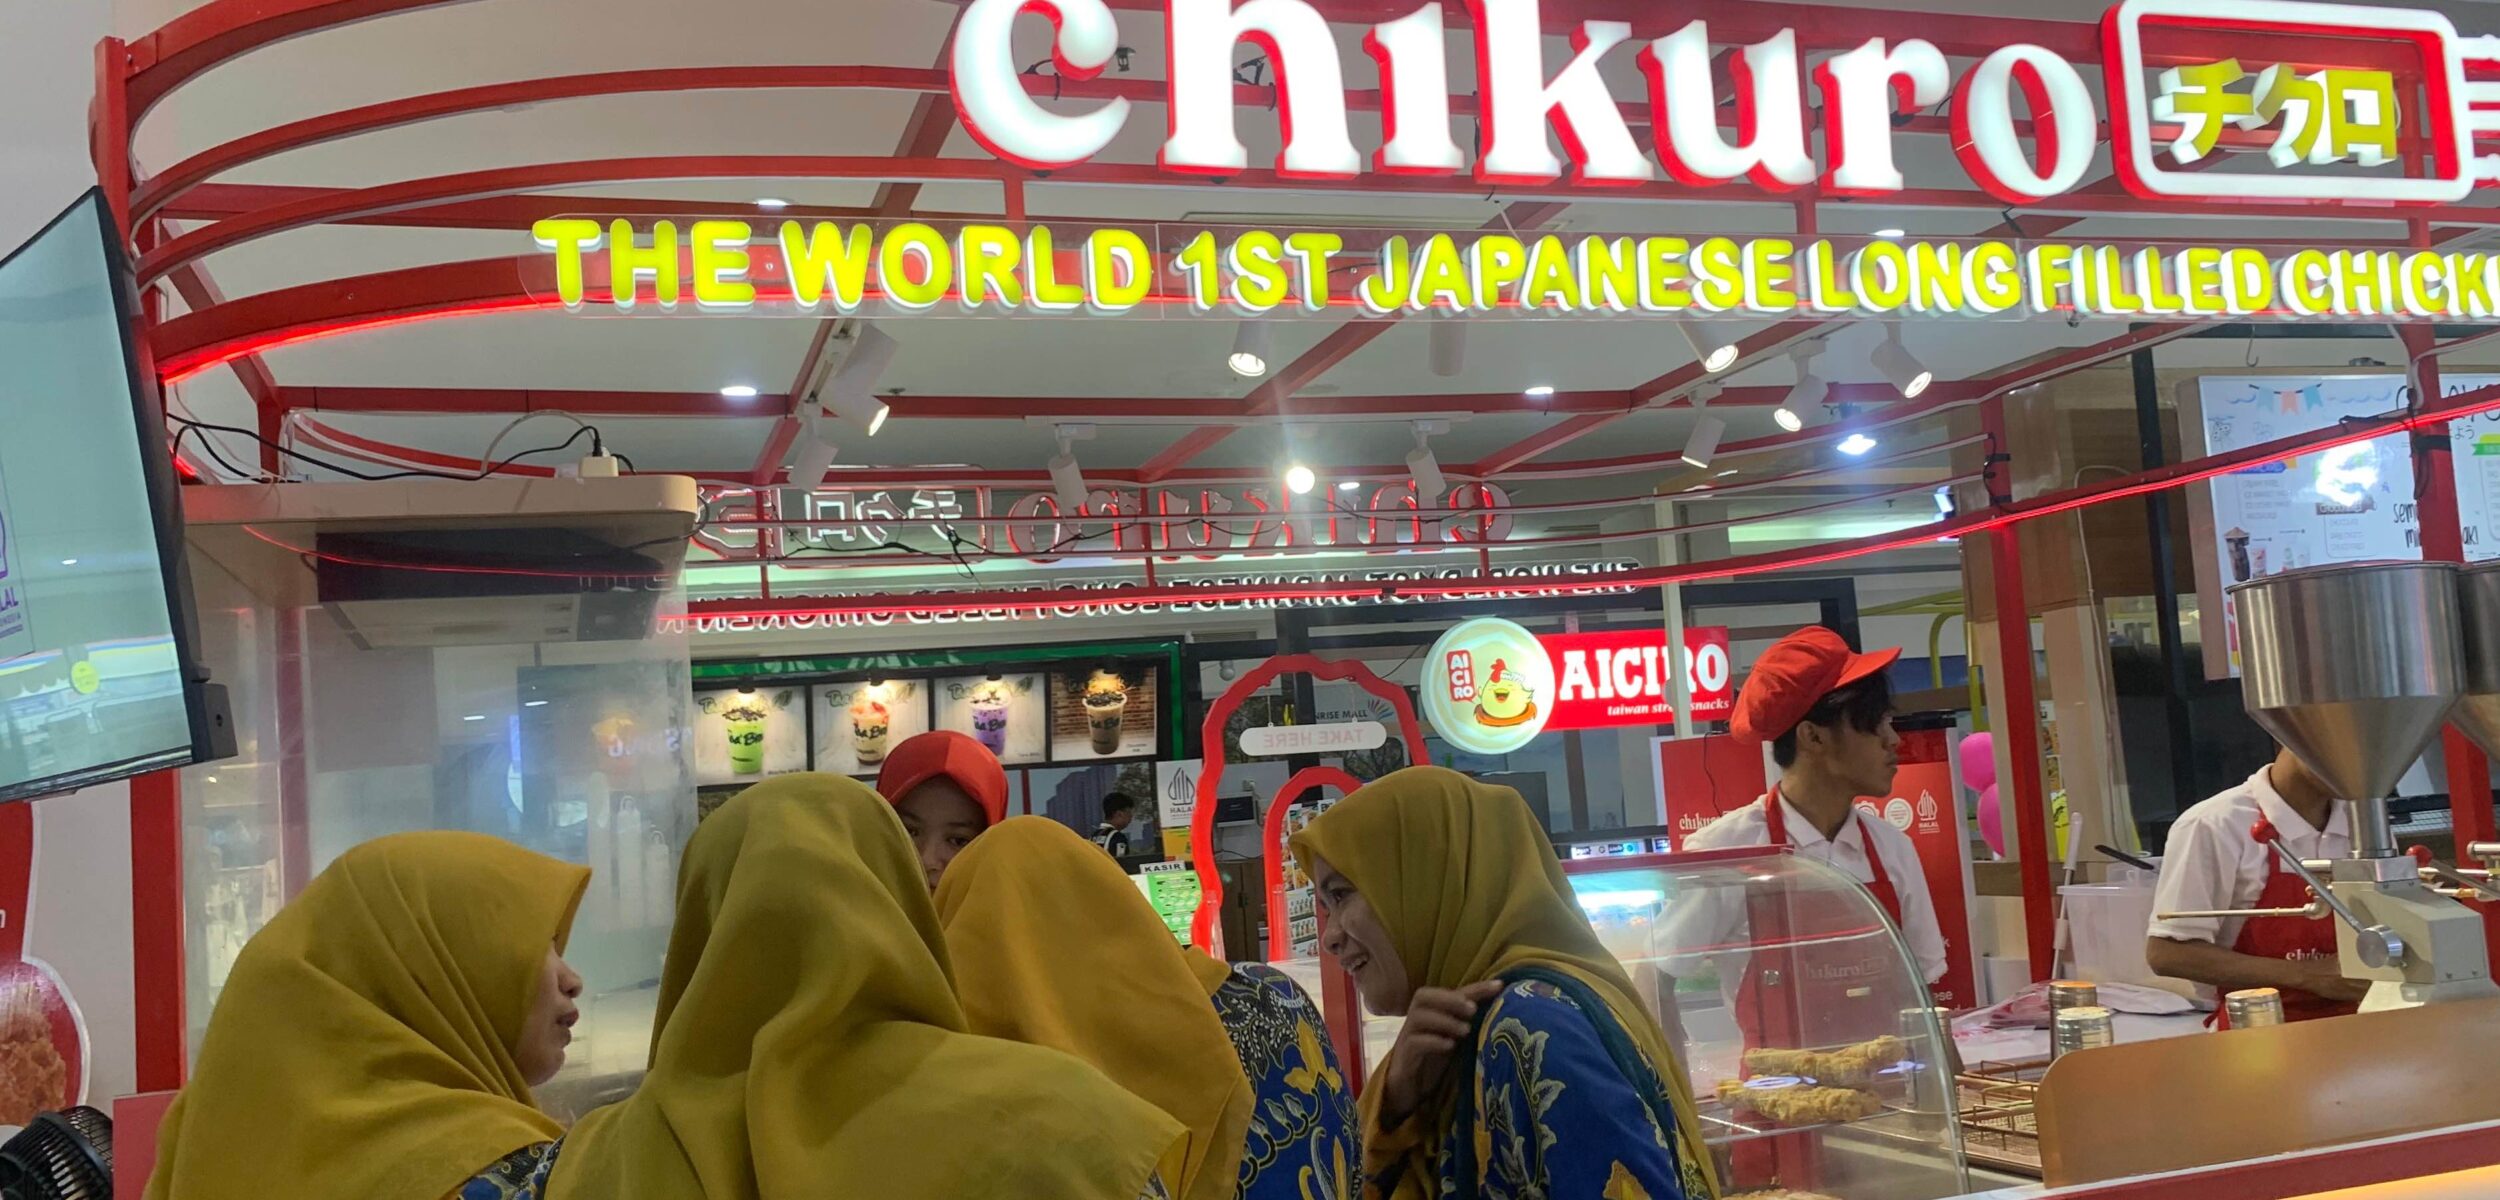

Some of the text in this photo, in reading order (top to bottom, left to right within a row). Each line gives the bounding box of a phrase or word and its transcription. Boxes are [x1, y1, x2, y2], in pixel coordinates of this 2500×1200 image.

[949, 0, 2098, 203] chikuro
[2152, 57, 2400, 168] チクロ
[532, 218, 757, 308] THE
[779, 219, 1153, 310] WORLD
[1175, 229, 1343, 312] 1ST
[1358, 232, 1798, 314] JAPANESE
[1808, 239, 2021, 315] LONG
[2028, 244, 2273, 315] FILLED
[1450, 653, 1469, 669] AI
[1451, 669, 1471, 686] CI
[1453, 685, 1474, 700] RO
[1315, 709, 1368, 720] NRISE MALL
[1608, 699, 1729, 716] taiwan stre snacks
[1169, 806, 1196, 814] HALA
[1679, 813, 1722, 831] chiku
[1144, 863, 1182, 873] KASIR
